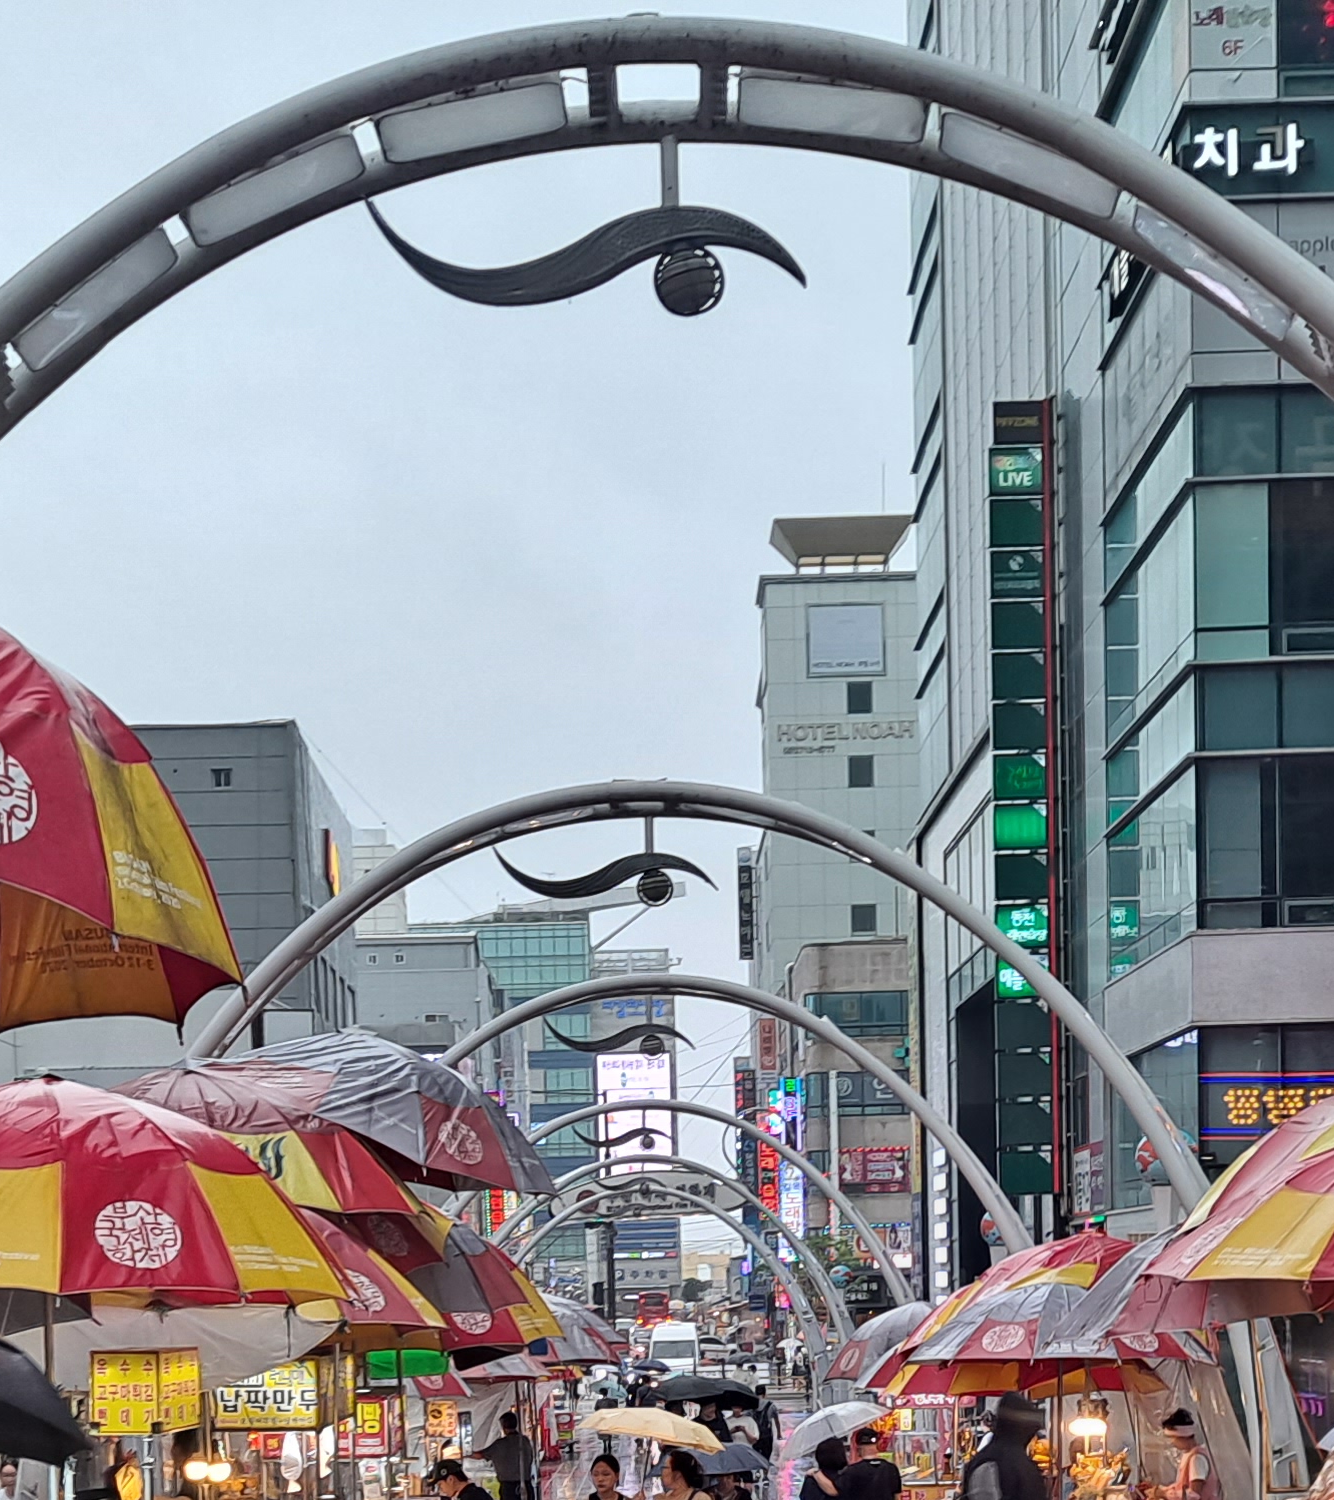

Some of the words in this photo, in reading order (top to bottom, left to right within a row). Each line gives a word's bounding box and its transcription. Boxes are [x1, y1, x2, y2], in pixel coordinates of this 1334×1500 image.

[1222, 39, 1244, 56] 6F
[1193, 121, 1305, 177] 치과
[998, 471, 1033, 487] LIVE
[219, 1388, 318, 1414] 납짝만두
